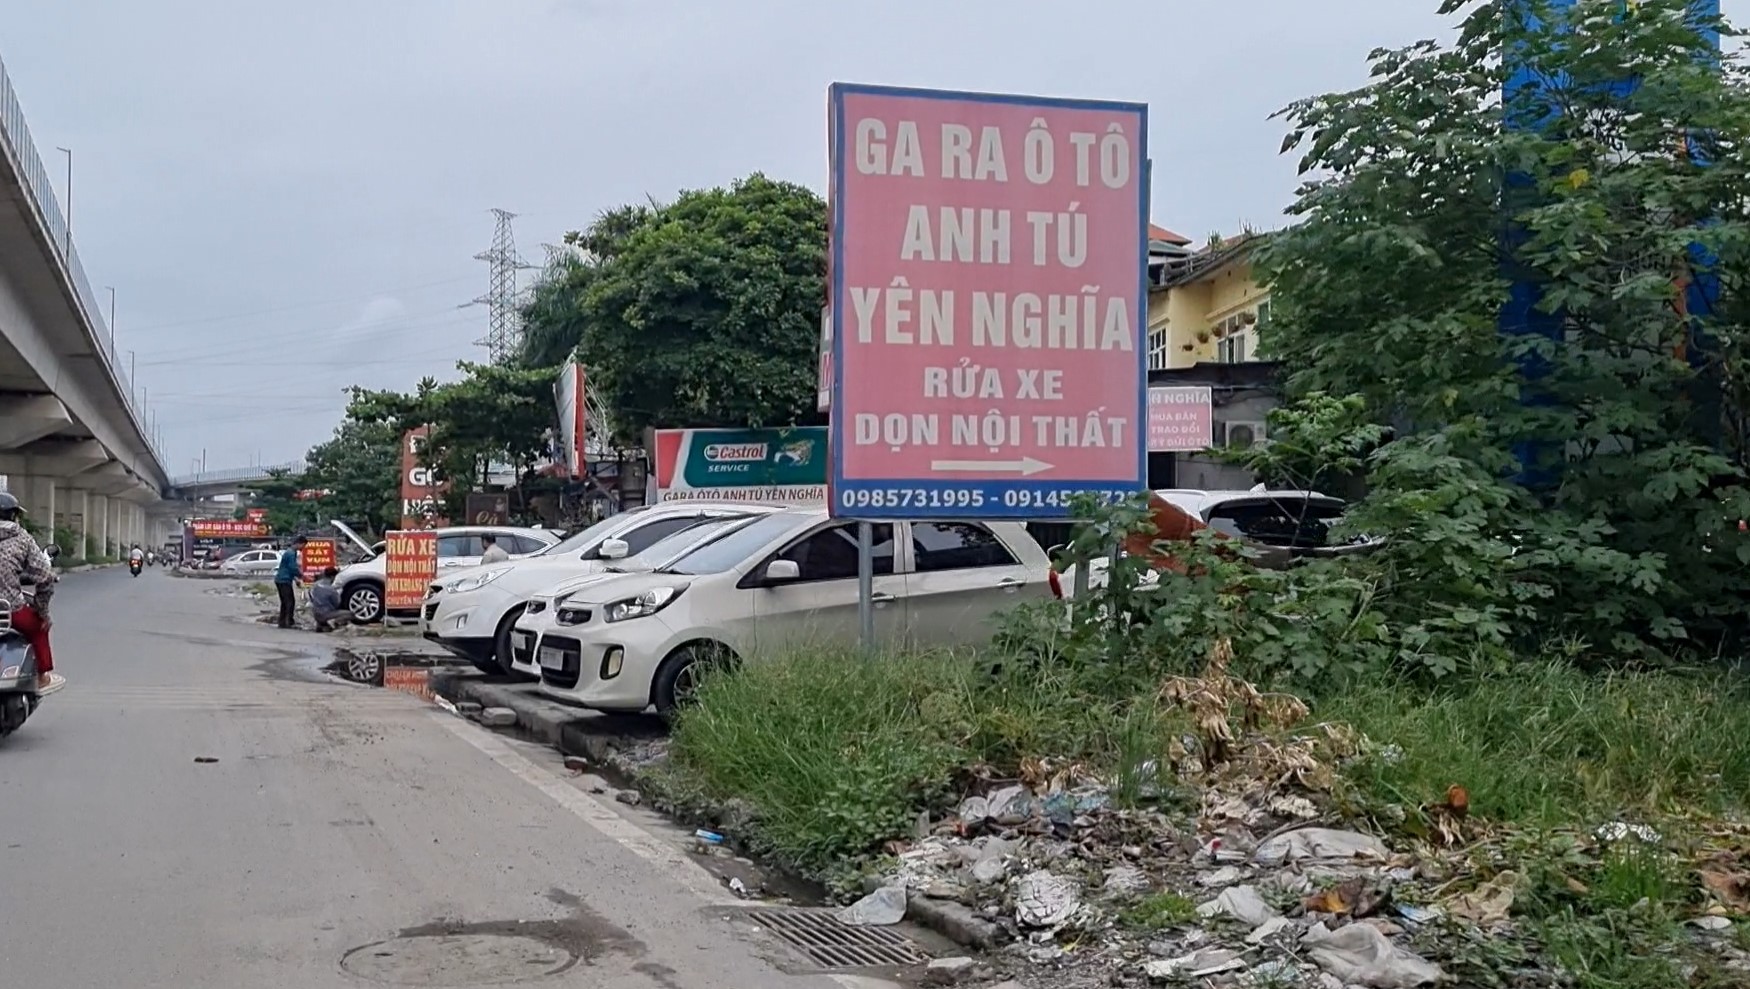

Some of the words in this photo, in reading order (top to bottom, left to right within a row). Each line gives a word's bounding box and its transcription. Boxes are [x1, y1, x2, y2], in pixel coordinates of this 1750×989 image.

[855, 117, 924, 177] GA
[941, 123, 1008, 182] RA
[1024, 117, 1054, 184] Ô
[1070, 122, 1130, 189] TÔ
[901, 205, 1011, 264] ANH
[1027, 201, 1088, 268] TÚ
[849, 276, 954, 346] YÊN
[972, 284, 1133, 351] NGHĨA
[924, 357, 1004, 399] RỬA
[1016, 369, 1064, 400] XE
[855, 413, 939, 453] DỌN
[952, 408, 1021, 453] NỘI
[1032, 406, 1127, 448] THẤT
[720, 444, 764, 459] Castrol
[708, 464, 750, 473] SERVICE
[722, 488, 746, 501] ANH
[748, 485, 763, 501] TÚ
[765, 485, 787, 501] YÊN
[788, 487, 824, 501] NGHĨA
[842, 489, 984, 508] 0985731995
[388, 534, 415, 555] RỬA
[419, 539, 437, 555] XE
